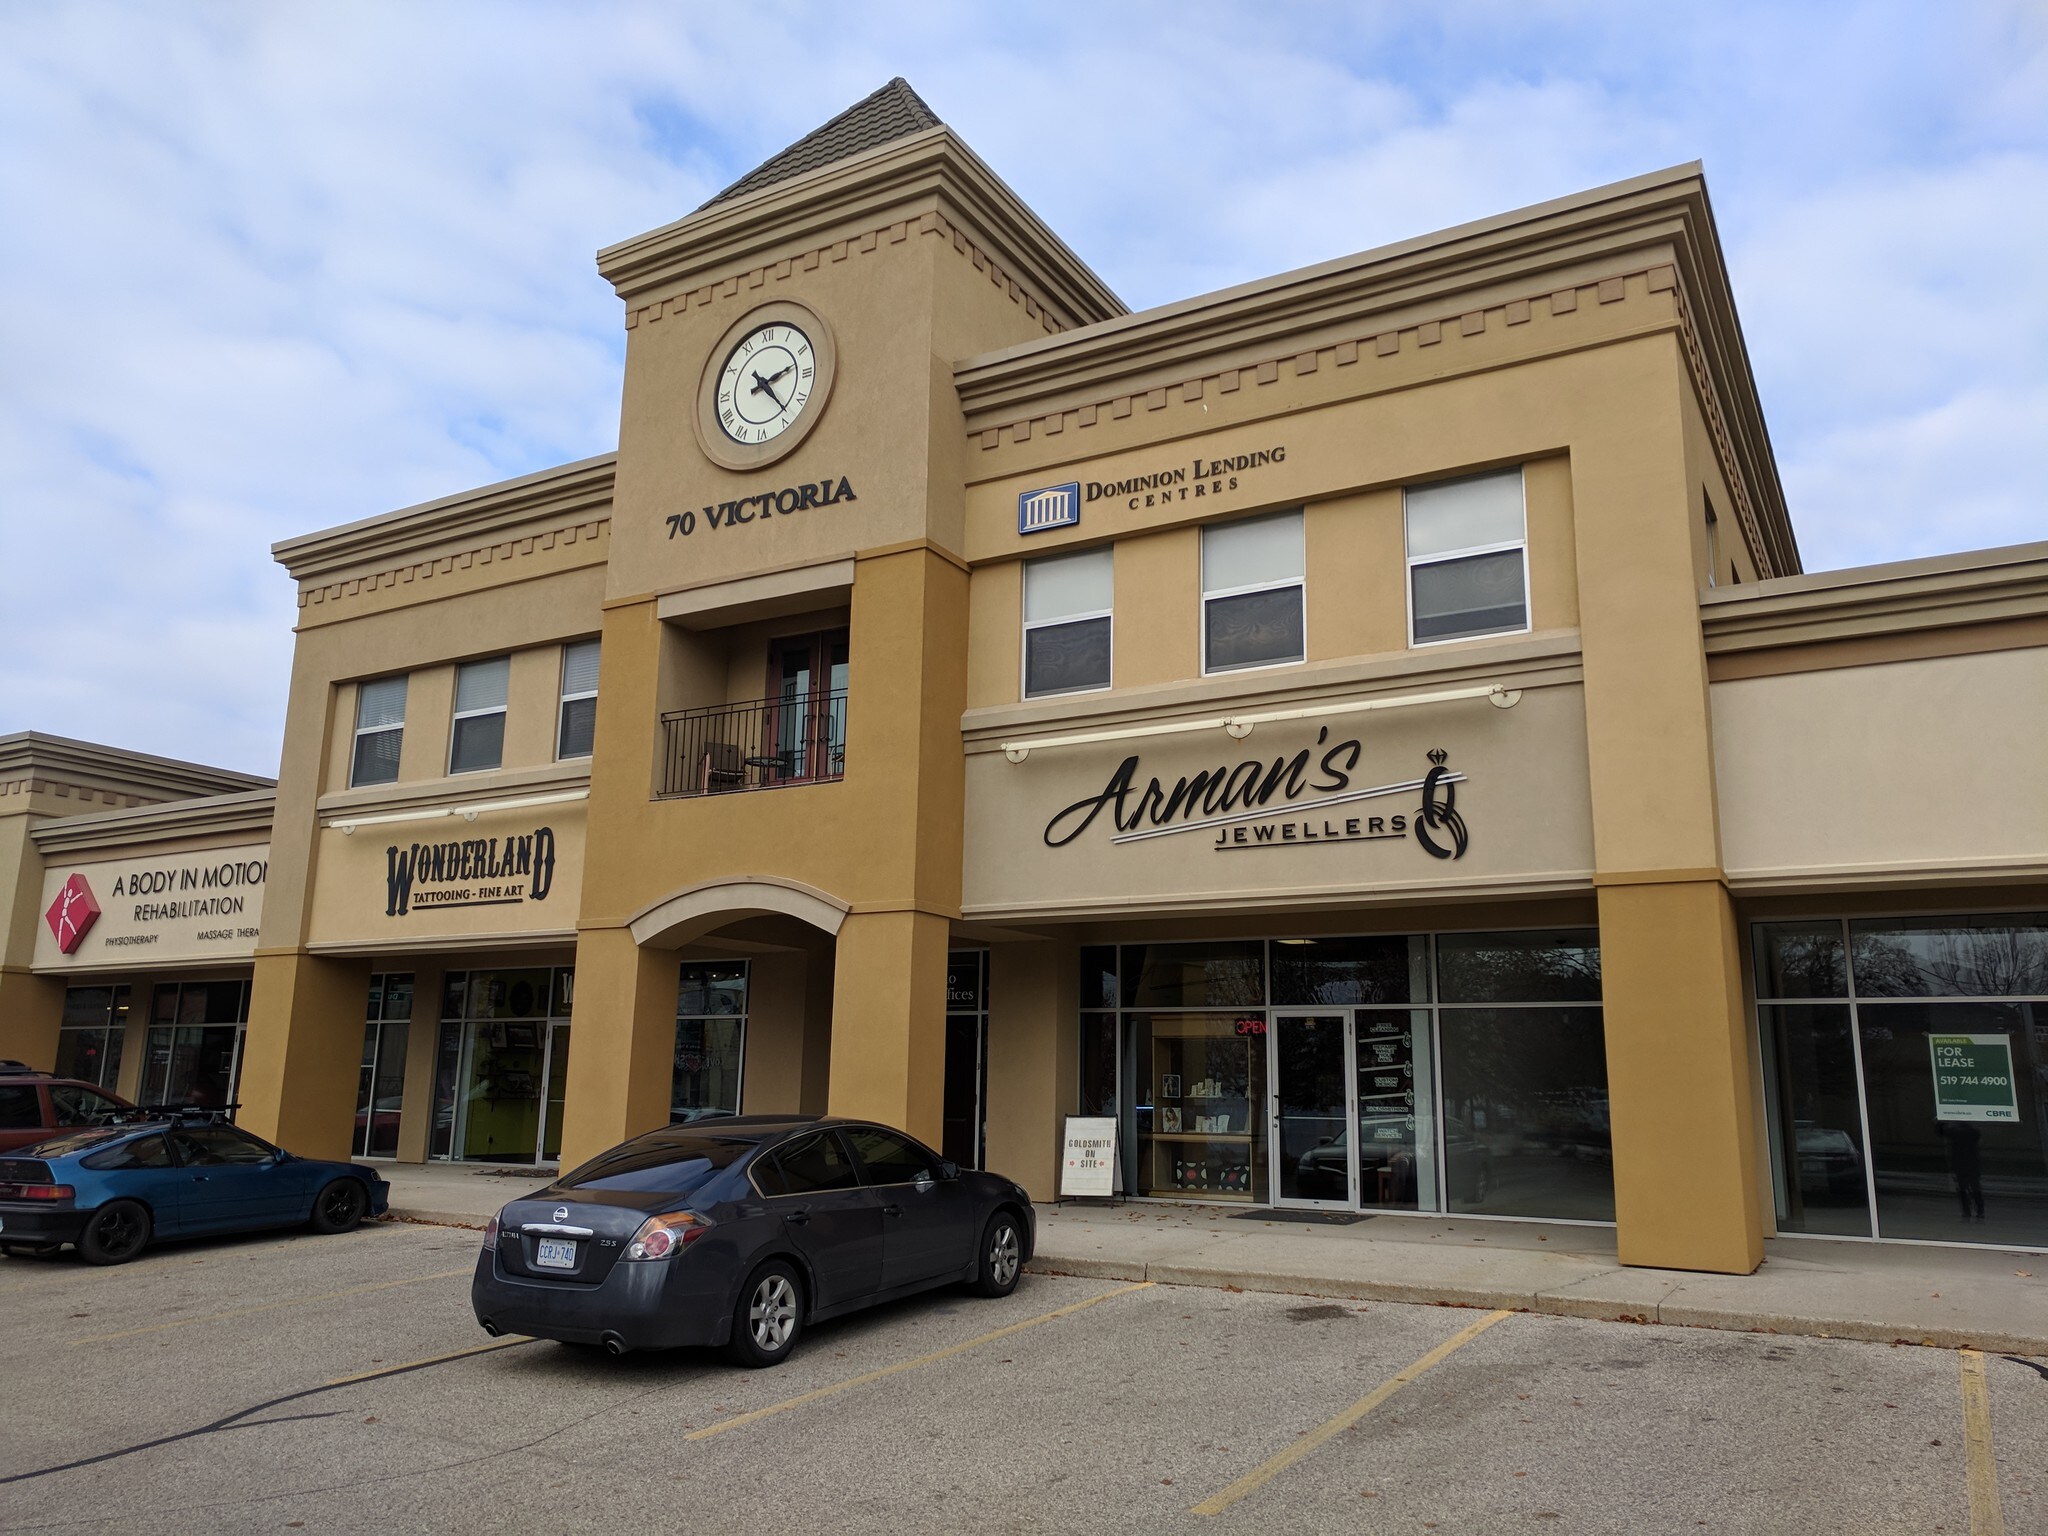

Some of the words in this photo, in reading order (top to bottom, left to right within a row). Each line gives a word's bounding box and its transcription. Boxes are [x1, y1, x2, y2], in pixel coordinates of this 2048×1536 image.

[762, 329, 774, 343] XII
[785, 331, 792, 342] I
[742, 341, 754, 356] XI
[797, 344, 808, 356] II
[727, 365, 738, 375] X
[802, 367, 813, 379] III
[780, 417, 789, 429] V
[1085, 467, 1185, 502] DOMINION
[1192, 446, 1286, 480] LENDING
[1128, 476, 1239, 510] CENTRES
[665, 511, 696, 540] 70
[703, 475, 857, 530] VICTORIA
[1044, 725, 1361, 847] Arman's
[1216, 815, 1407, 844] JEWELLERS
[385, 826, 555, 916] WONDERLAND
[112, 876, 124, 897] A
[129, 869, 177, 896] BODY
[180, 867, 198, 891] IN
[413, 889, 470, 903] TATTOOING
[479, 886, 501, 899] FINE
[504, 884, 524, 897] ART
[133, 896, 244, 922] REHABILITATION
[105, 934, 159, 947] PHYSIOTHERAPY
[197, 929, 233, 941] MASSAGE
[237, 927, 260, 938] THERA
[947, 987, 974, 1000] fices
[1237, 1020, 1267, 1034] OPEN
[1937, 1047, 1962, 1056] FOR
[1938, 1058, 1975, 1067] LEASE
[1940, 1076, 1957, 1085] 519
[1960, 1076, 1978, 1085] 744
[1981, 1076, 2007, 1086] 4900
[1068, 1140, 1111, 1148] GOLDSMITH
[1085, 1150, 1096, 1158] ON
[1080, 1160, 1097, 1168] SITE
